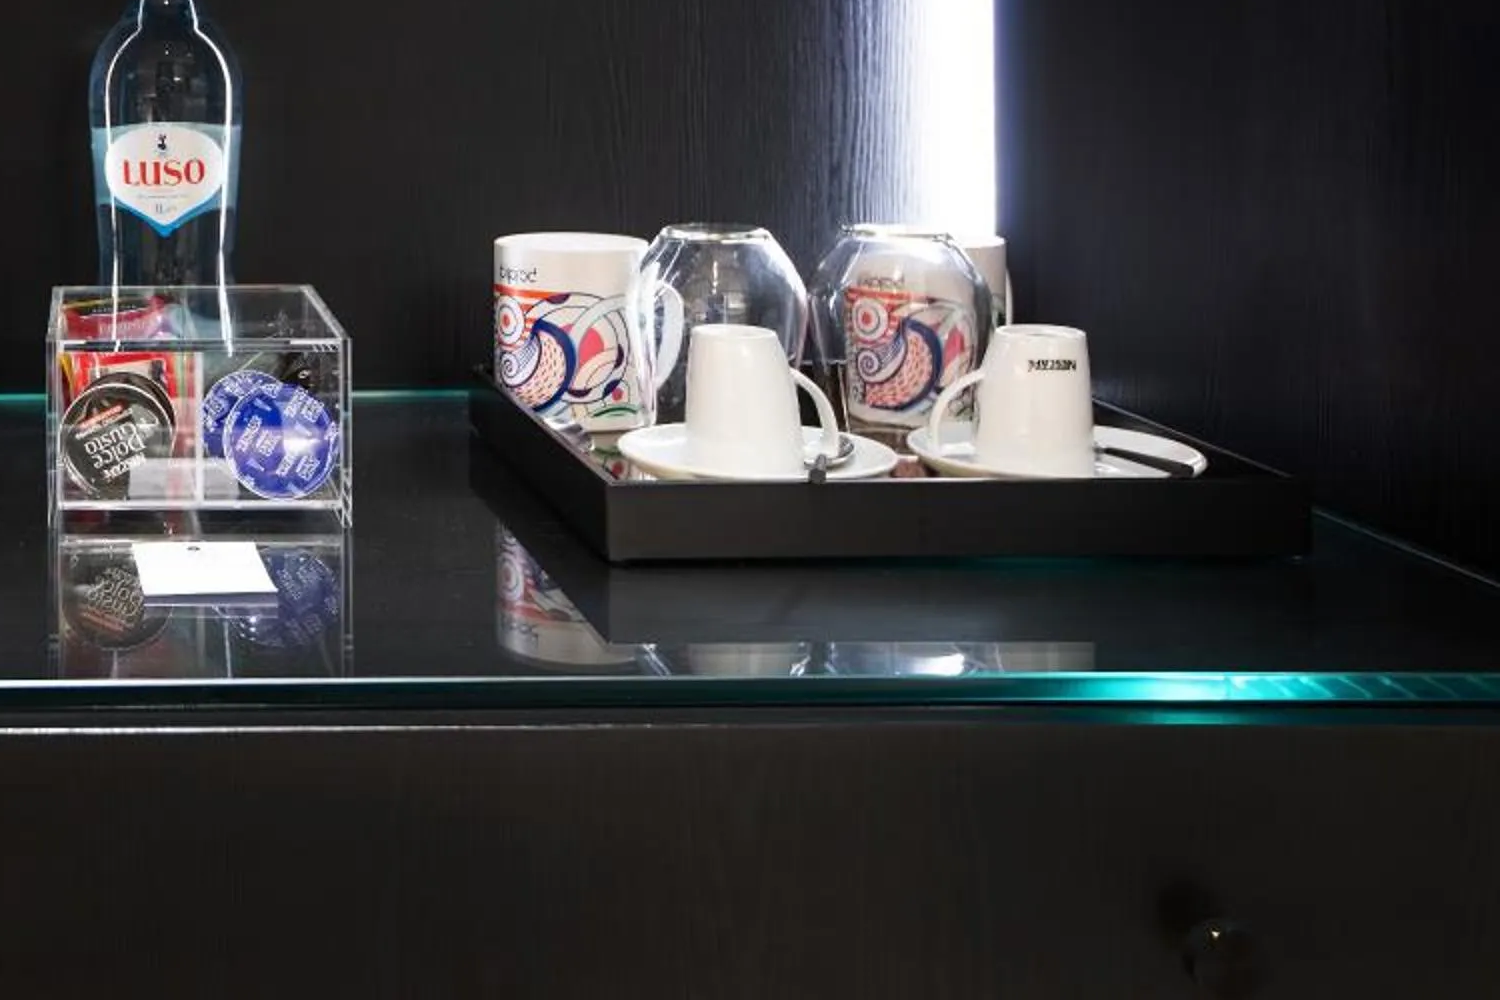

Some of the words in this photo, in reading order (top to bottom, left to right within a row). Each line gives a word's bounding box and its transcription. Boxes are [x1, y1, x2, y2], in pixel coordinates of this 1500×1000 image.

[122, 158, 205, 186] LUSO
[84, 421, 137, 455] Gusto
[91, 433, 146, 469] Dolce
